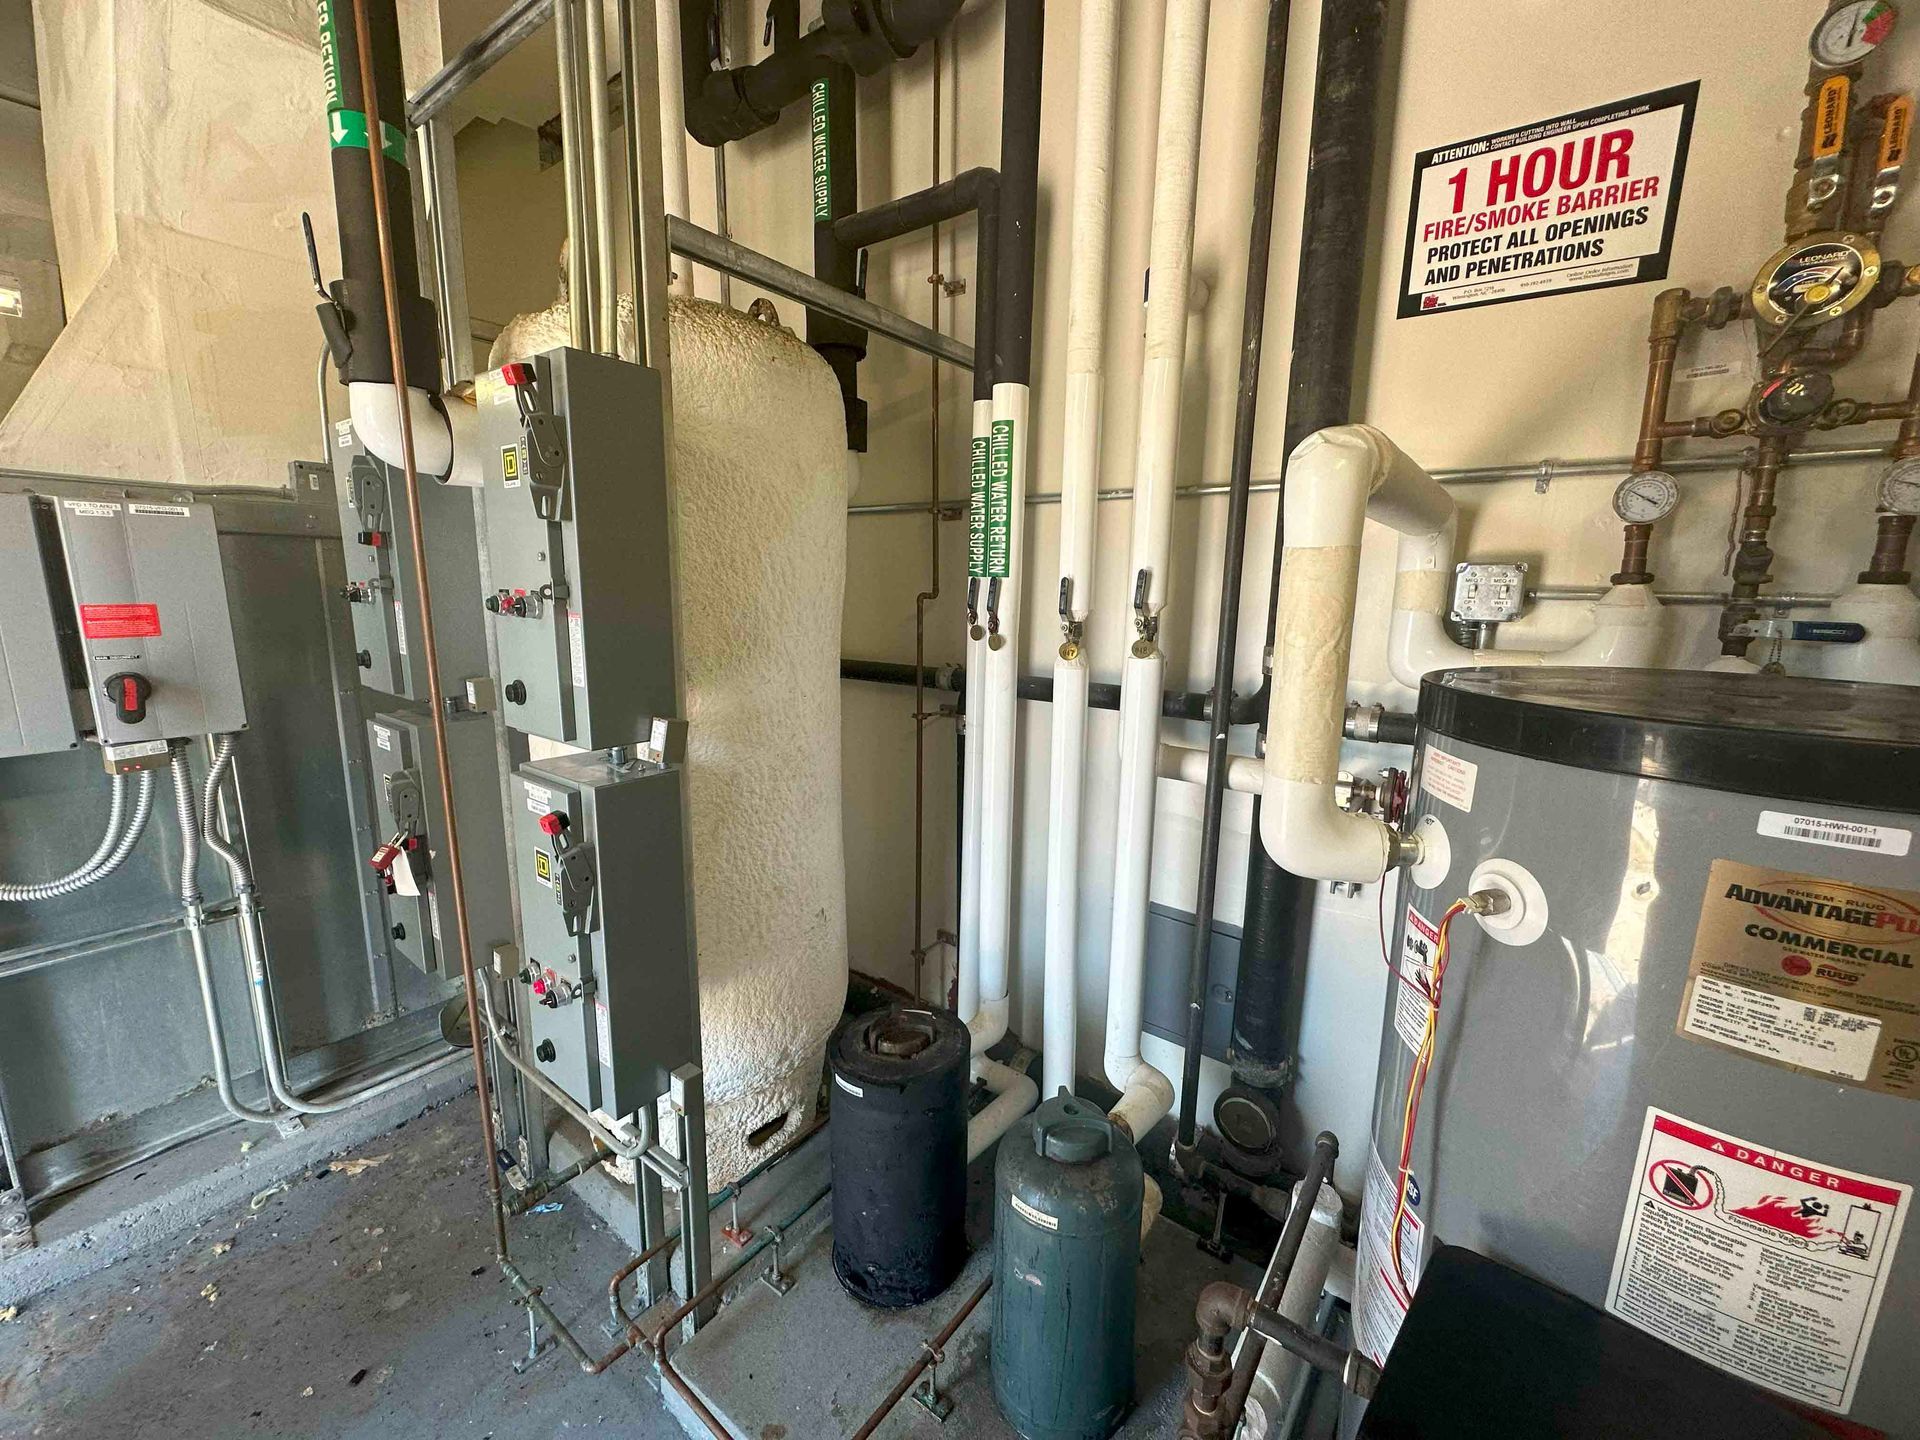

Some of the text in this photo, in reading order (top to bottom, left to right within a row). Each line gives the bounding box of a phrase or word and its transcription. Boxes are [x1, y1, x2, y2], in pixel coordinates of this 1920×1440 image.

[320, 31, 338, 104] RETURN
[1490, 103, 1650, 150] CONTACT BUILDING ENGINEER UPON COMPLETING WORK
[1491, 117, 1576, 144] WORKMEN CUTTING INTO WALL
[1824, 88, 1836, 134] LEONARD
[812, 83, 828, 217] CHILLED WATER SUPPLY
[1431, 139, 1490, 165] ATTENTION:
[1444, 125, 1636, 216] 1 HOUR
[1423, 174, 1661, 242] FIRE/SMOKE BARRIER
[1427, 205, 1650, 264] PROTECT ALL OPENINGS
[1424, 237, 1605, 285] AND PENETRATIONS
[1800, 250, 1848, 264] LEONARD
[968, 441, 986, 574] CHILLED WATER SUPPLY
[988, 426, 1009, 574] CHILLED WATER RETURN
[1794, 817, 1878, 836] 07015-HWH-001-1
[1786, 888, 1886, 911] RHEEM RUUD
[1744, 924, 1914, 968] COMMERCIAL
[1816, 967, 1860, 982] RUUD
[1736, 1149, 1840, 1188] DANGER
[1639, 1227, 1669, 1244] products
[1670, 1241, 1687, 1252] such
[1640, 1216, 1691, 1242] severe burns.
[1642, 1211, 1662, 1223] catch
[1664, 1220, 1676, 1229] fire
[1678, 1226, 1709, 1243] causing
[1710, 1240, 1733, 1253] death
[1643, 1206, 1733, 1248] liquids will explode and
[1657, 1207, 1747, 1247] Vapors from flammable
[1727, 1214, 1809, 1249] Flammable Vapors
[1634, 1246, 1651, 1257] Keep
[1637, 1236, 1655, 1247] same
[1656, 1244, 1674, 1255] room
[1718, 1272, 1730, 1280] the
[1651, 1227, 1662, 1235] not
[1663, 1232, 1676, 1241] use
[1686, 1242, 1704, 1254] store
[1706, 1251, 1743, 1270] flammable
[1722, 1268, 1734, 1277] the
